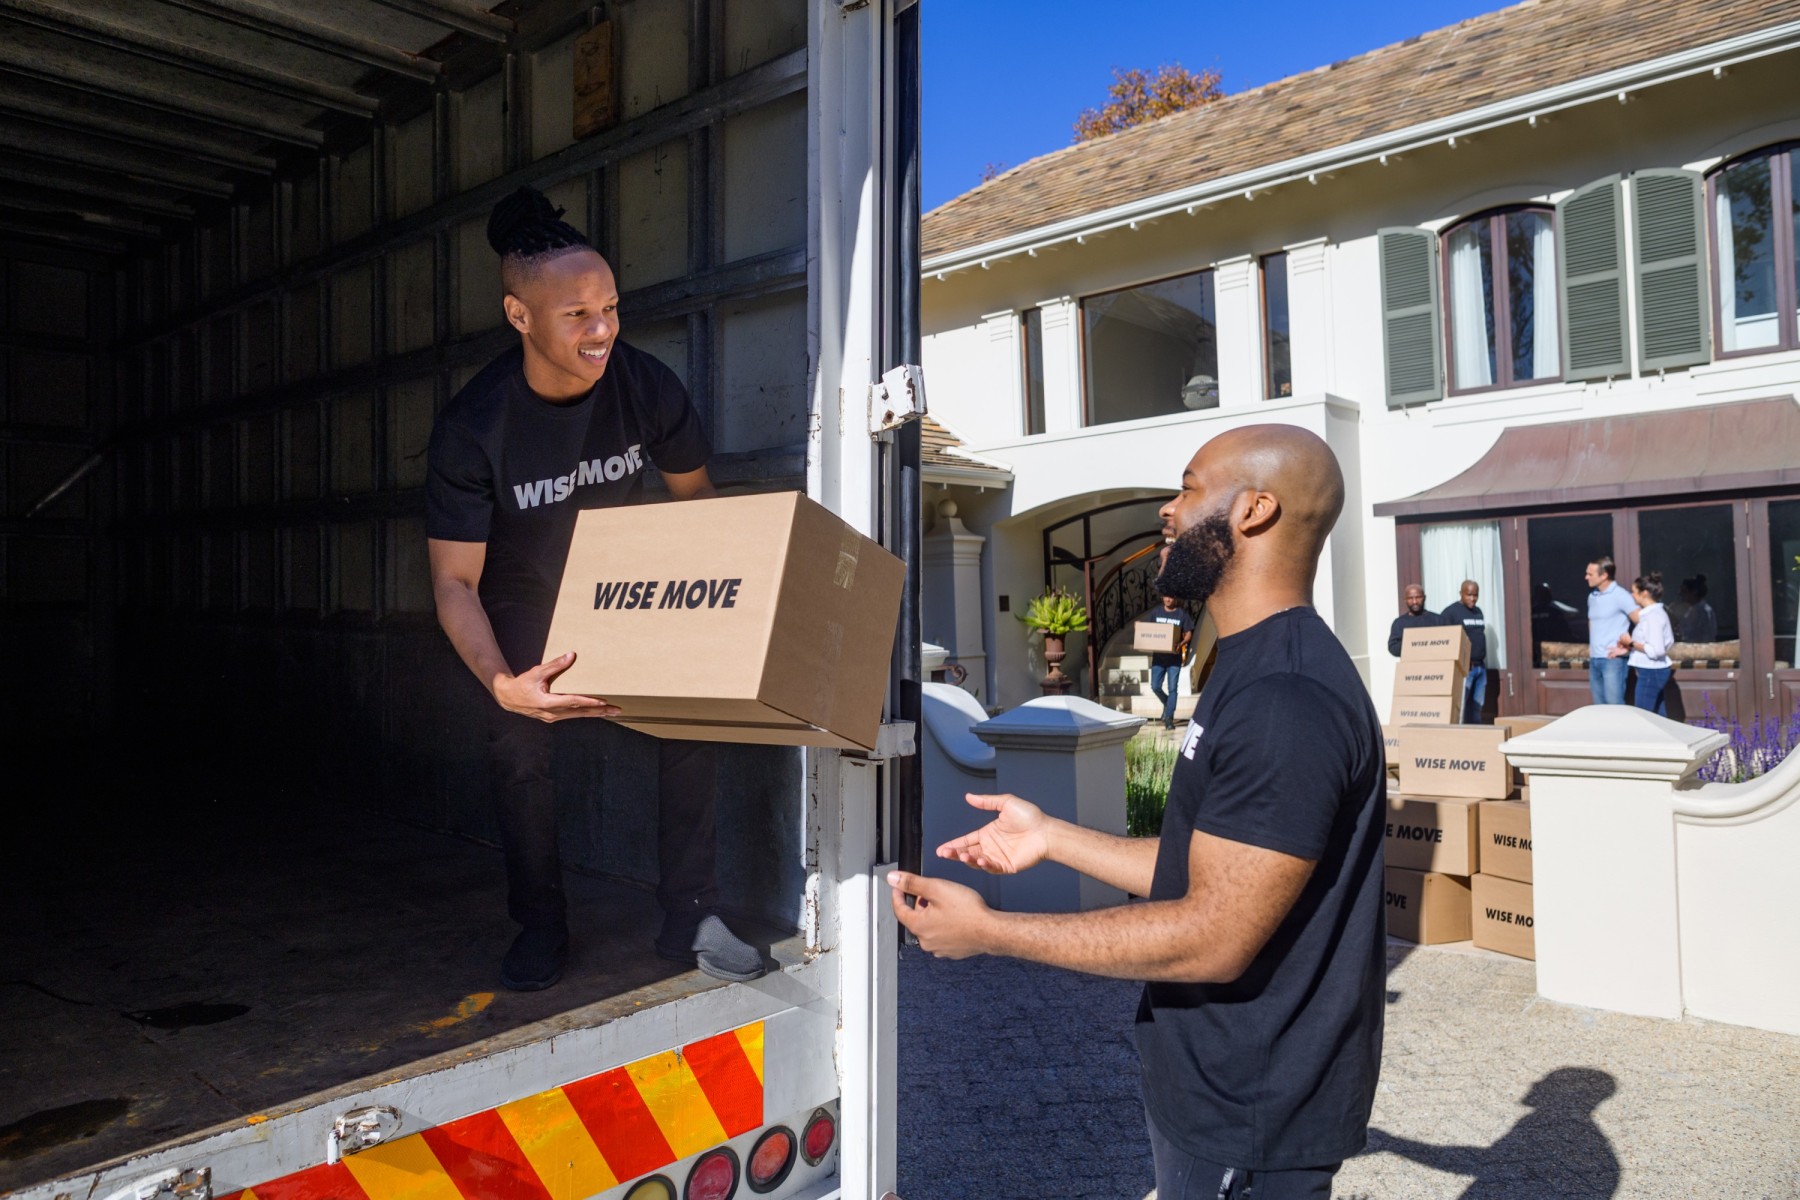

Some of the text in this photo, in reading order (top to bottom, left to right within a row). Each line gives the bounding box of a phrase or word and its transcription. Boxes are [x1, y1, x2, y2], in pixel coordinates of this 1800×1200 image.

[513, 444, 643, 510] WISE MOVE
[593, 578, 742, 610] WISE MOVE
[1415, 758, 1486, 772] WISE MOVE
[1397, 825, 1443, 843] MOVE
[1493, 833, 1517, 848] WISE
[1386, 892, 1407, 910] OVE
[1485, 907, 1534, 928] WISE MO
